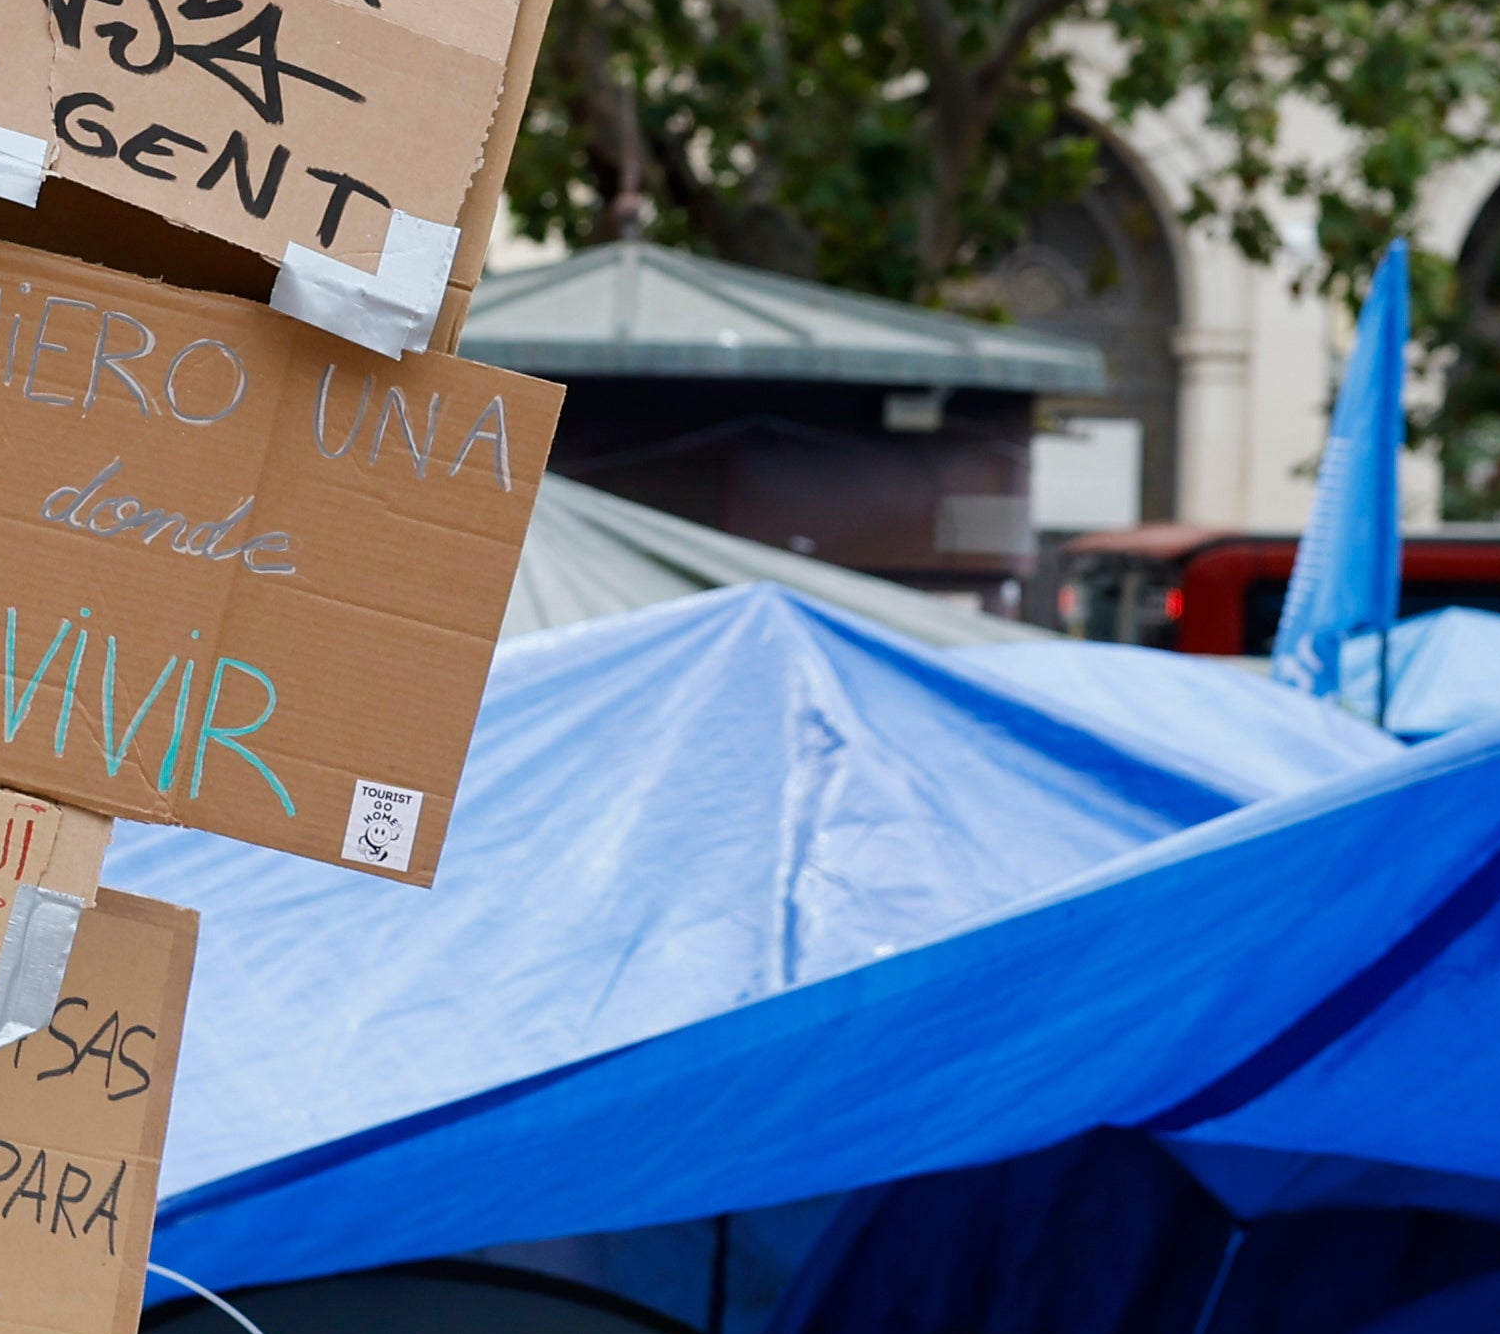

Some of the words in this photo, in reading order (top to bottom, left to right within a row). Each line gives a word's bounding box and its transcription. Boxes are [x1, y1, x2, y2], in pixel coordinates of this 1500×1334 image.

[53, 92, 392, 250] GENT
[311, 362, 514, 494] UNA
[39, 456, 296, 577] donde
[362, 786, 412, 805] TOURIST
[363, 812, 398, 826] HOME
[374, 801, 392, 811] GO
